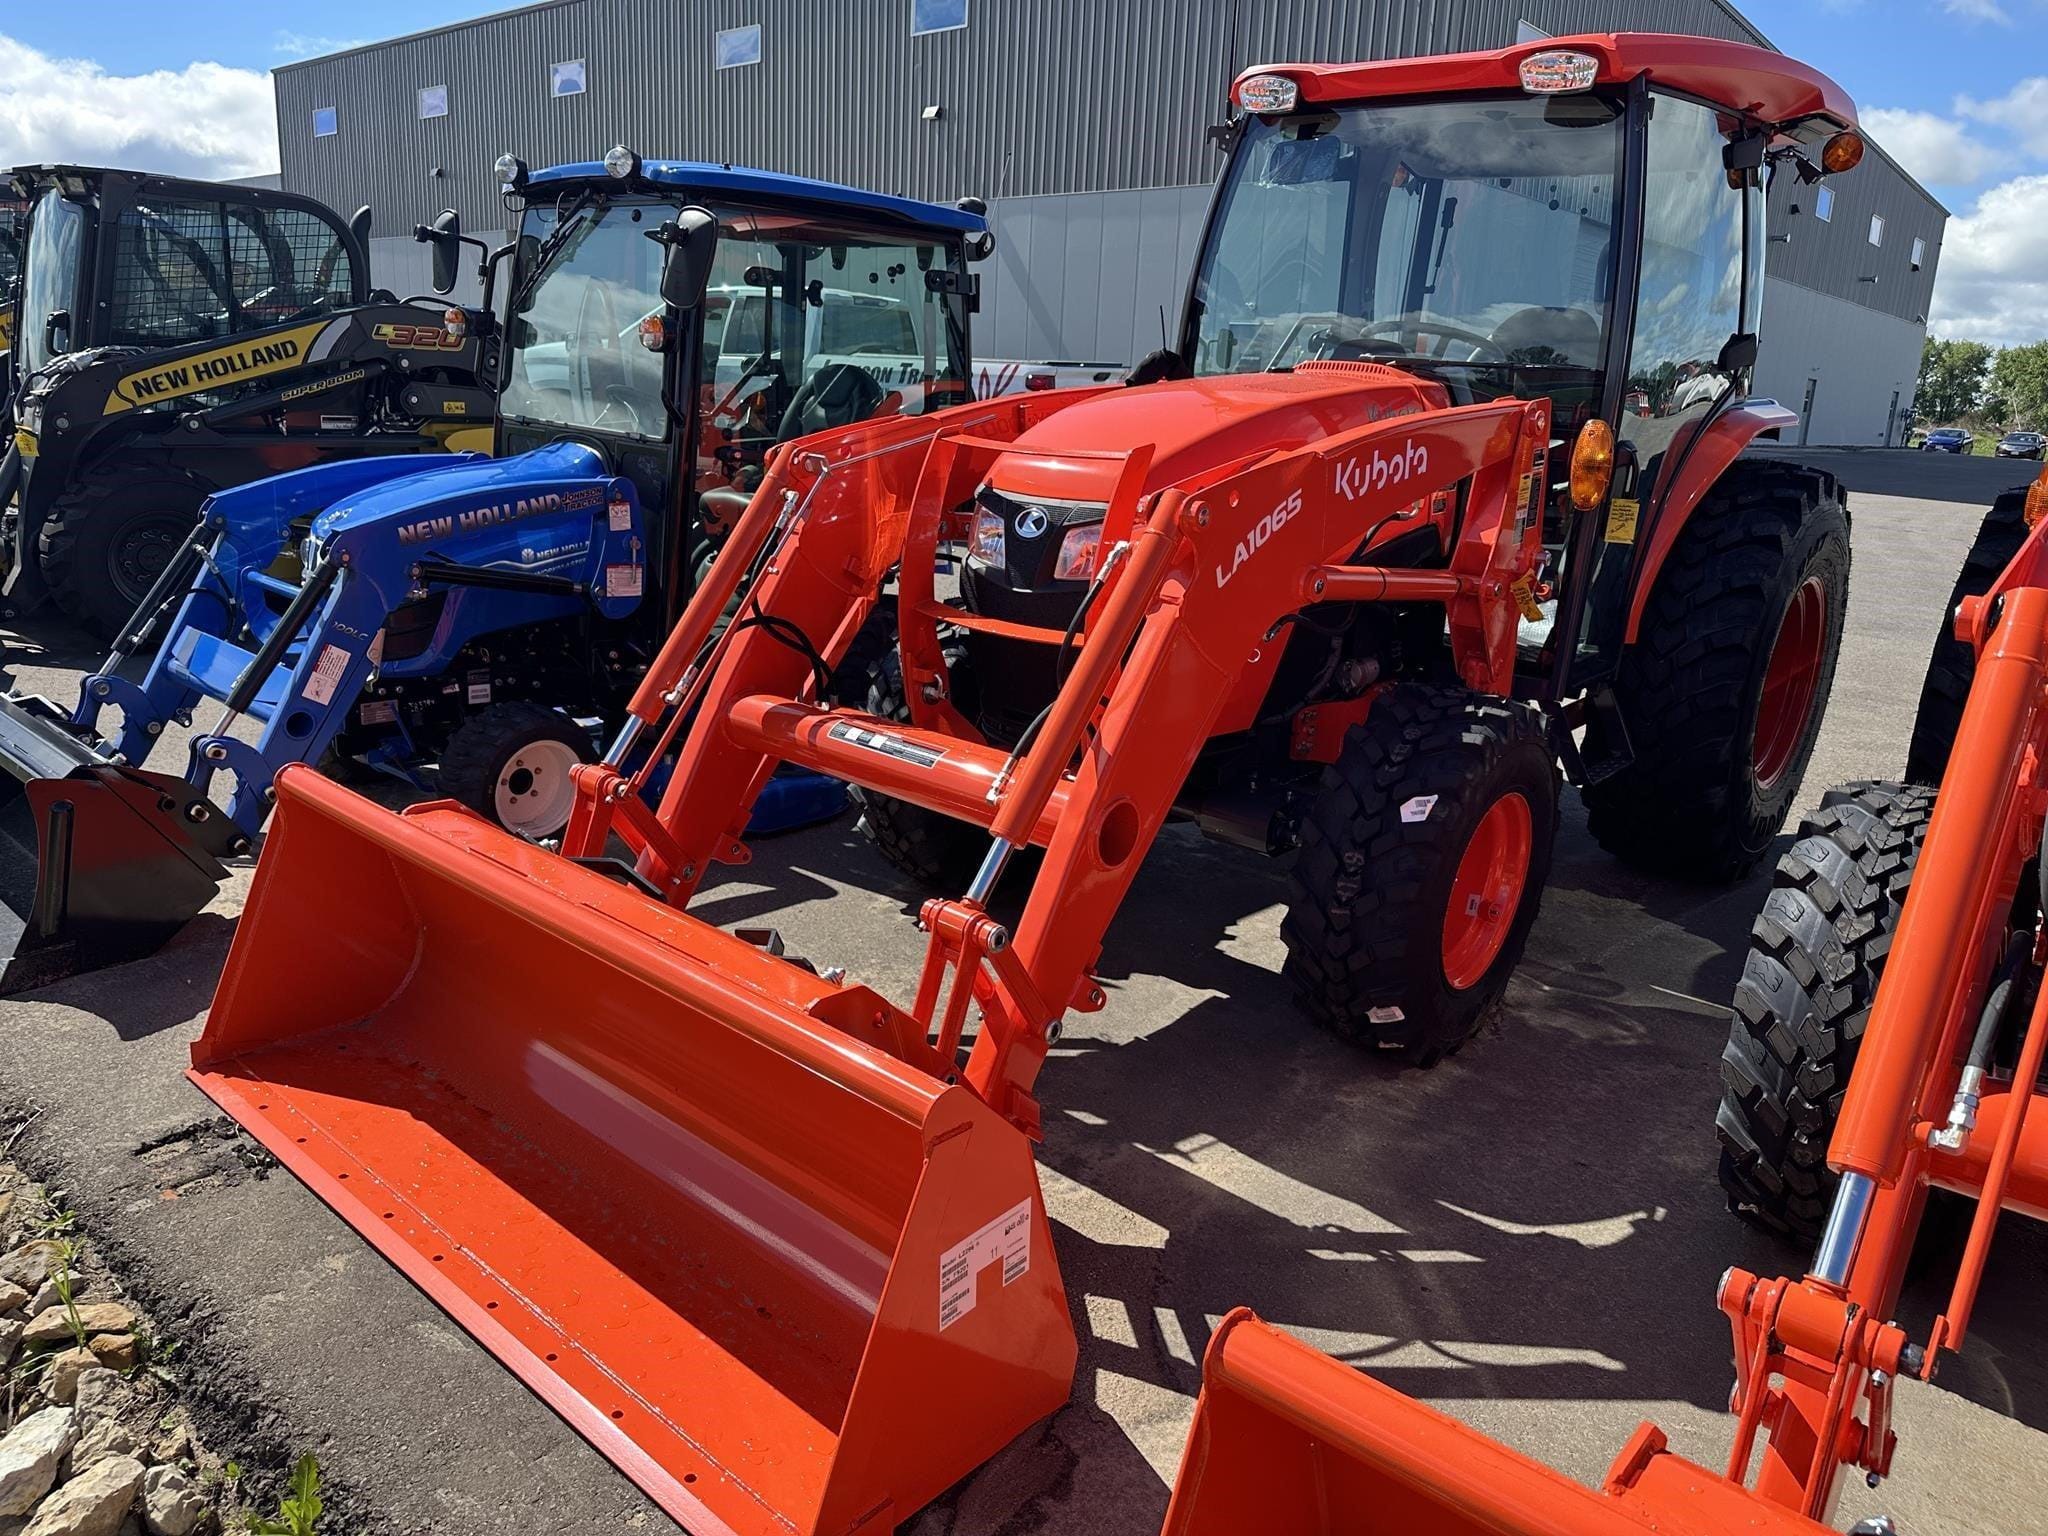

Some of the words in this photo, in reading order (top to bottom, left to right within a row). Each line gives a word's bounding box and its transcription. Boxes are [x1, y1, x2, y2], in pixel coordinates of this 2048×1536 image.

[372, 324, 466, 351] L320
[131, 368, 189, 398] NEW
[198, 340, 299, 382] HOLLAND
[281, 381, 327, 401] SUPER
[326, 369, 365, 388] BOOM
[1335, 439, 1427, 501] Kubota
[397, 516, 453, 544] NEW
[459, 493, 562, 532] HOLLAND
[1215, 488, 1302, 588] LA1065
[536, 547, 560, 561] NEW
